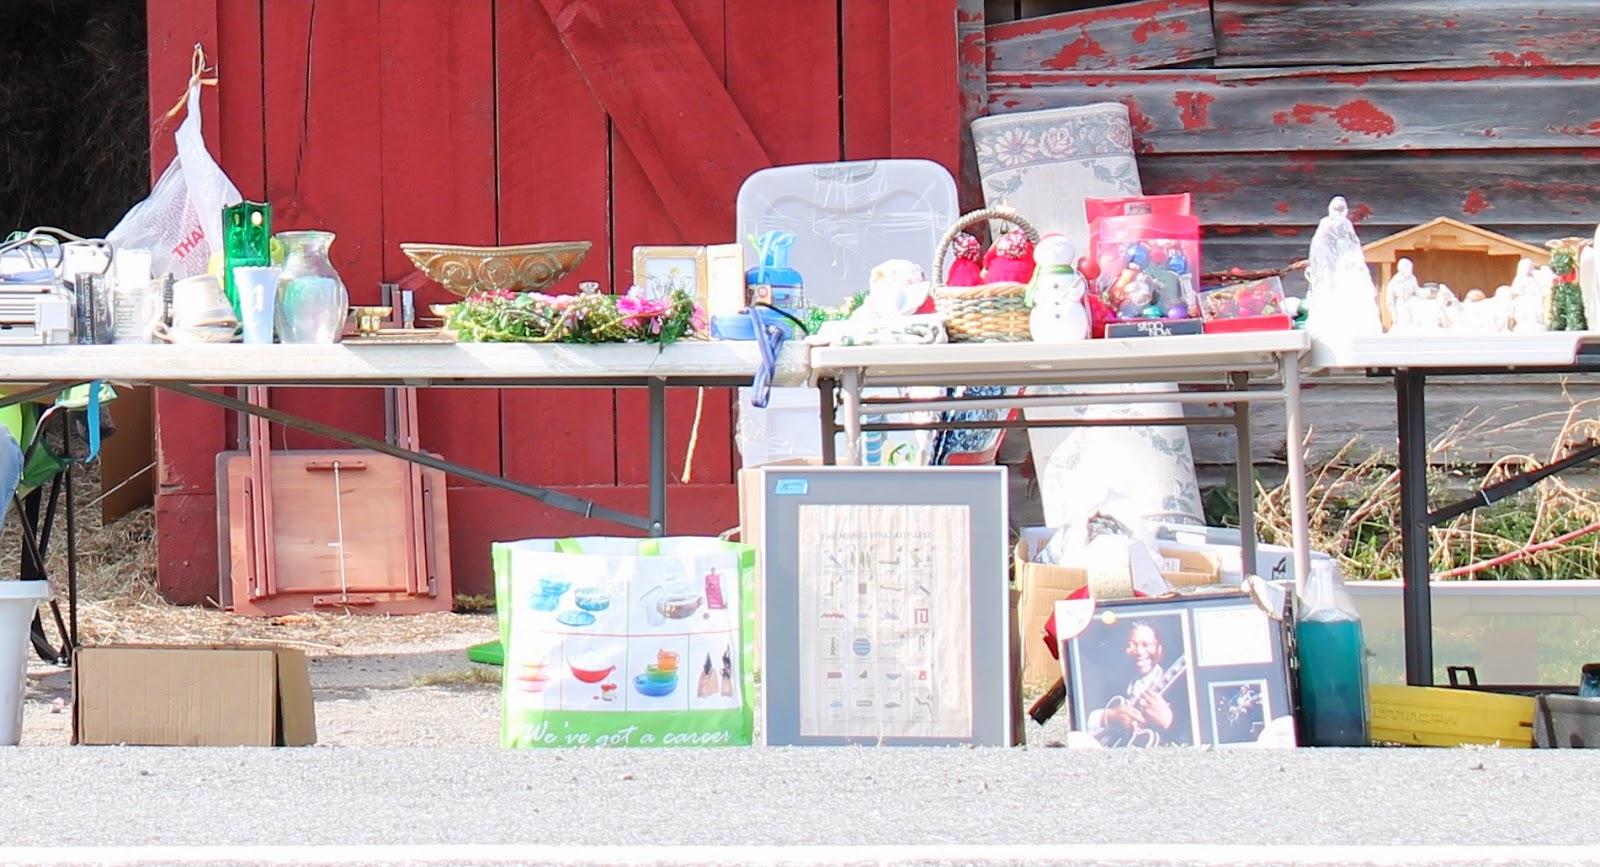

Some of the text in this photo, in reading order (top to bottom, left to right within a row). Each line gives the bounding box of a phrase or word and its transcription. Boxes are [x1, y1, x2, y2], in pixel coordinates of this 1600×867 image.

[523, 720, 732, 747] We've got a career
